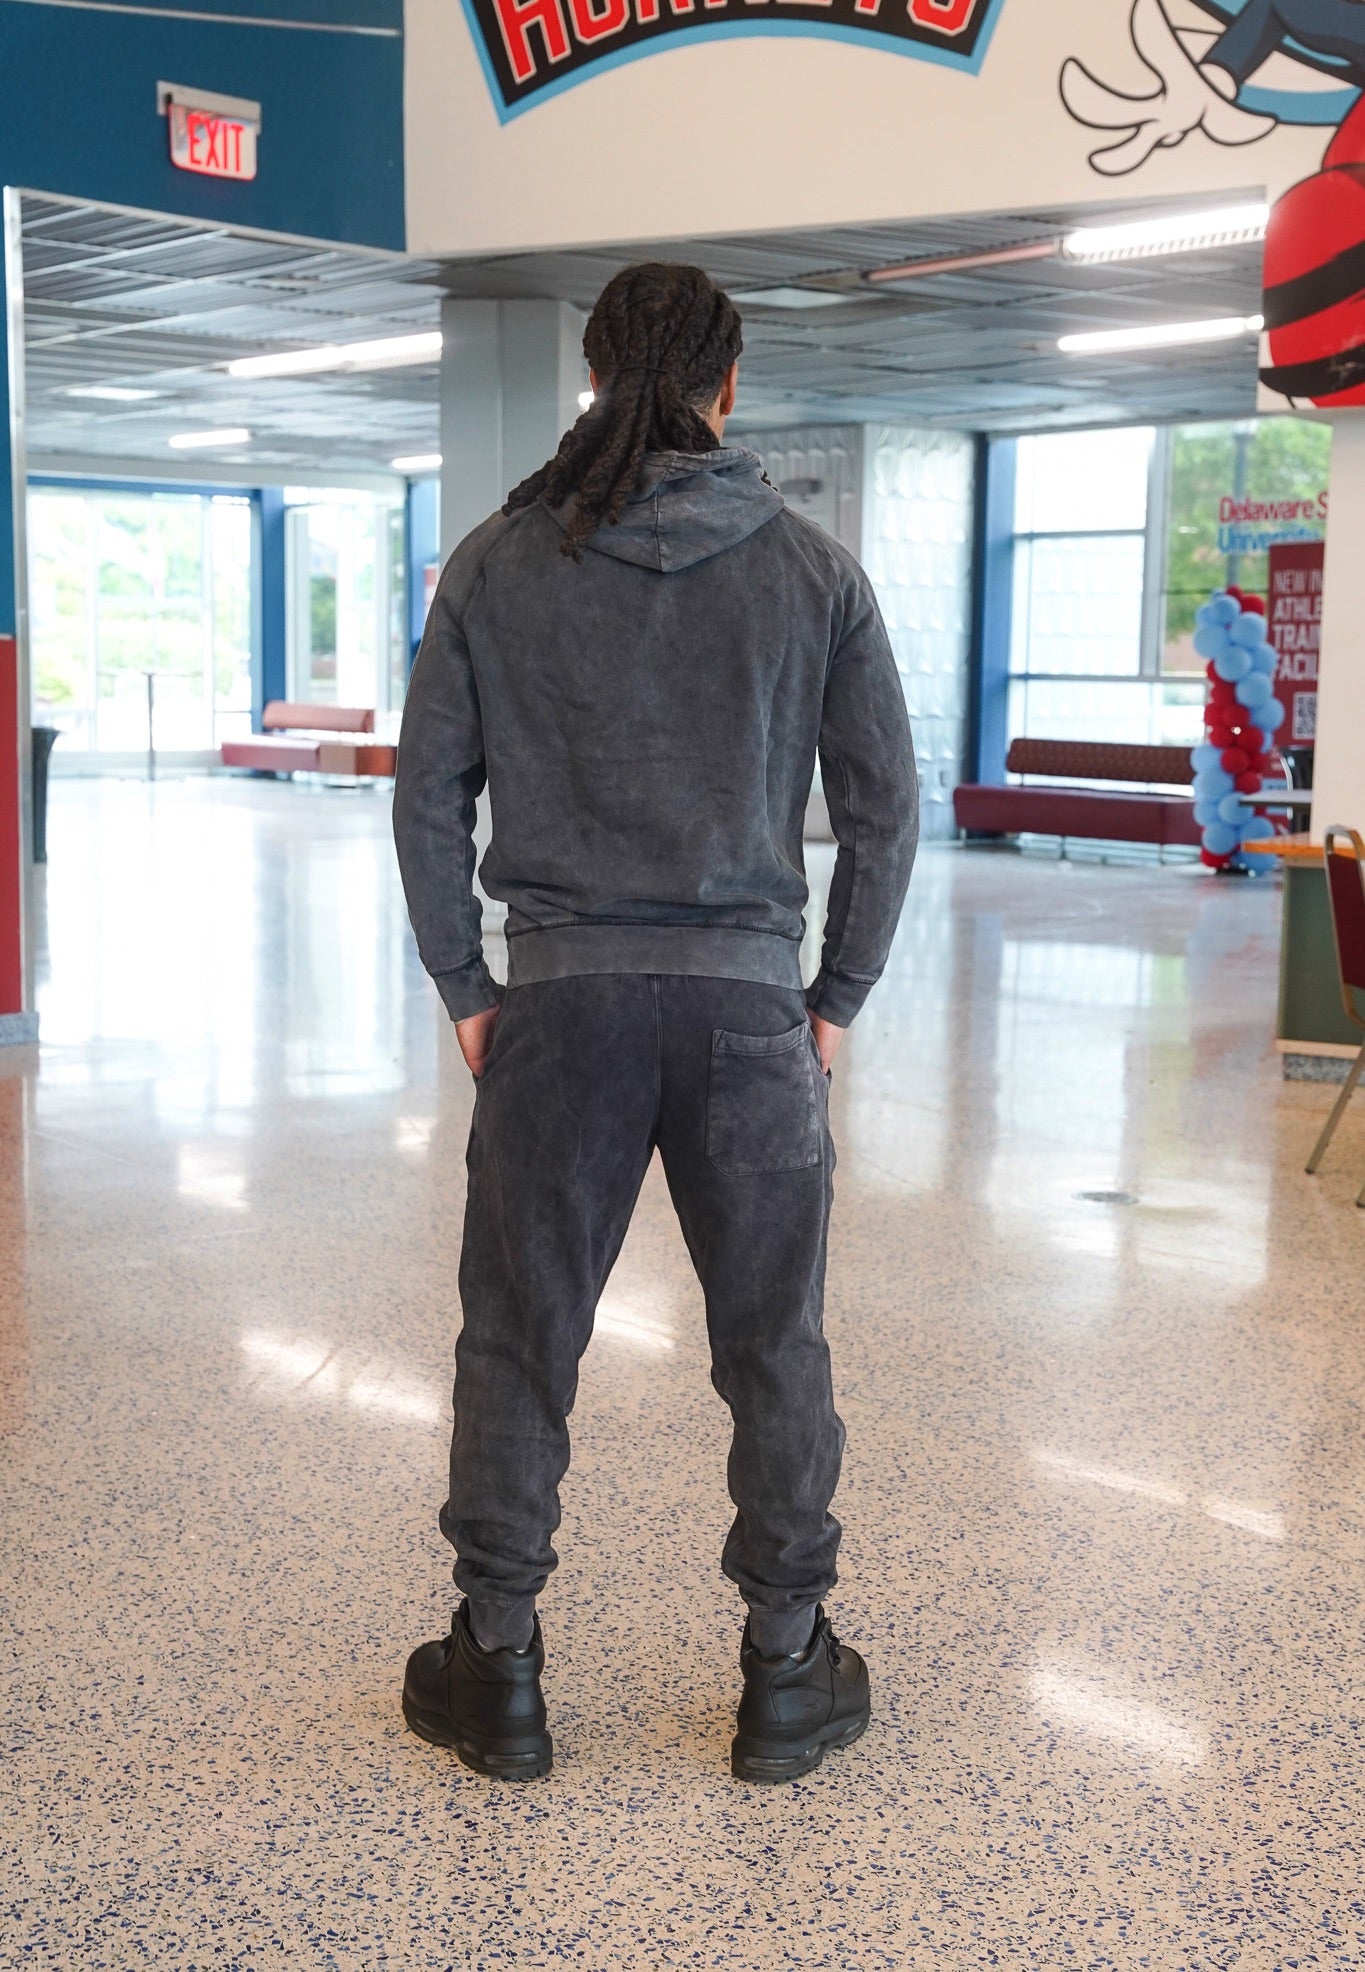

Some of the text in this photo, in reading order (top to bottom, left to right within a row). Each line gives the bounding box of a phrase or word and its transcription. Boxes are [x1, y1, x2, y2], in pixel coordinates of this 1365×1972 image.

[187, 113, 244, 172] EXIT
[1219, 496, 1314, 522] Delaware
[1274, 569, 1307, 594] NEW
